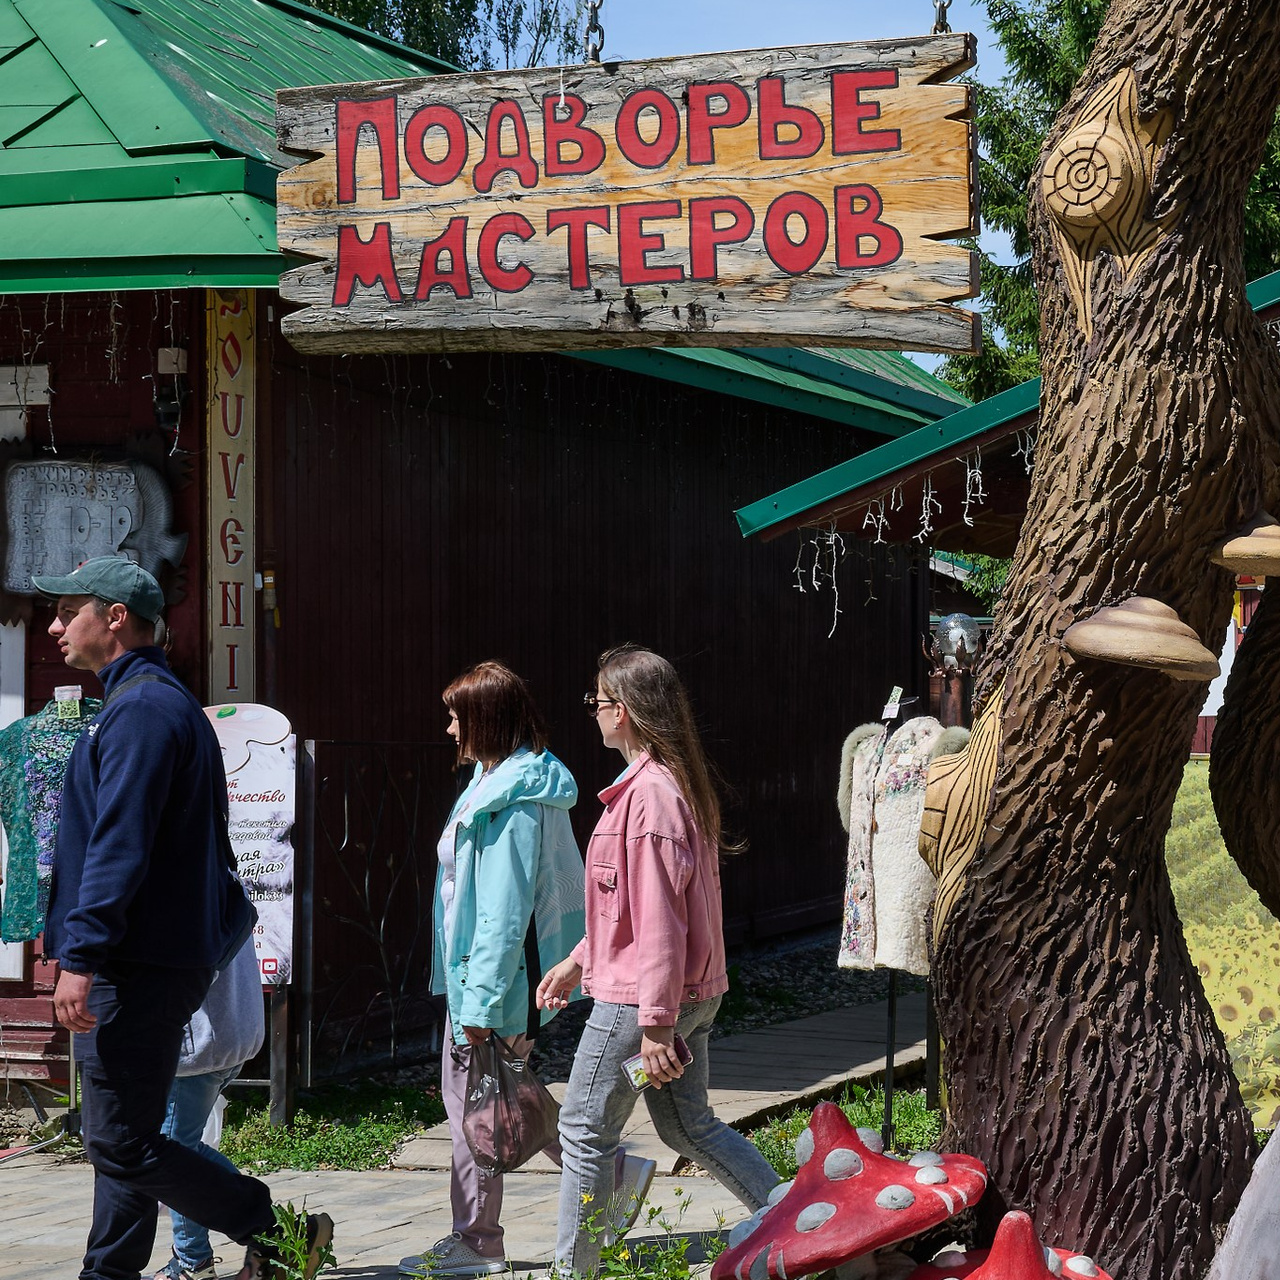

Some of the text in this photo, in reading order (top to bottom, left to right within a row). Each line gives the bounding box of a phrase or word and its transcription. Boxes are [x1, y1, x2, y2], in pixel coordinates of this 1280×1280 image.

[333, 68, 902, 205] ПОДВОРЬЕ
[331, 182, 905, 308] МАСТЕРОВ
[218, 297, 245, 691] SOUVENI
